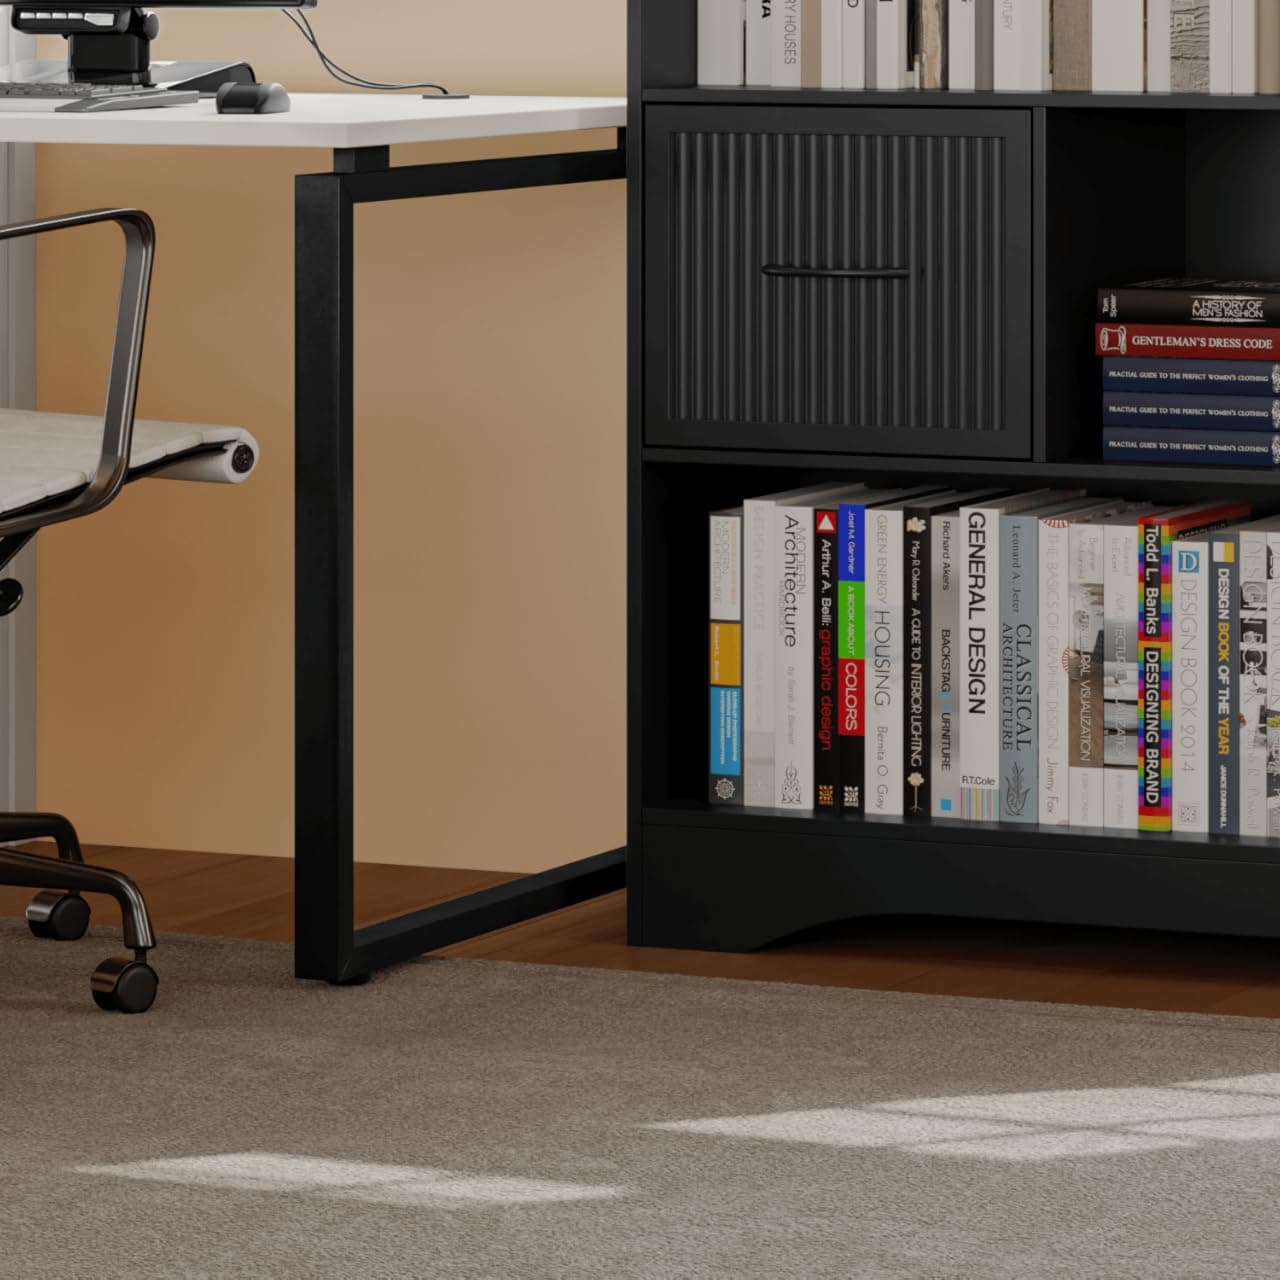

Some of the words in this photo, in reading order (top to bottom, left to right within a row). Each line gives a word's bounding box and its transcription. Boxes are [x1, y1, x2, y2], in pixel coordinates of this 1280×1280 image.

[784, 16, 797, 65] HOUSES
[1193, 301, 1200, 309] A
[1203, 300, 1243, 310] HISTORY
[1247, 301, 1262, 310] OF
[1226, 309, 1264, 318] FASHION
[1209, 336, 1241, 348] DRESS
[1244, 337, 1272, 349] CODE
[821, 539, 832, 578] Arthur
[942, 521, 951, 559] Richard
[1011, 525, 1021, 569] Leonard
[1145, 526, 1159, 562] Todd
[784, 514, 799, 648] Architecture
[821, 580, 832, 594] A.
[942, 561, 951, 591] Akers
[968, 512, 985, 620] GENERAL
[1011, 571, 1021, 584] A.
[1145, 568, 1159, 580] L.
[1011, 588, 1021, 613] Jeter
[1145, 588, 1159, 634] Banks
[1180, 579, 1197, 651] DESIGN
[1218, 568, 1229, 619] DESIGN
[817, 629, 833, 691] graphic
[874, 611, 891, 706] HOUSING
[1218, 622, 1229, 661] BOOK
[968, 627, 985, 714] DESIGN
[1002, 624, 1013, 751] ARCHITECTURE
[1016, 624, 1032, 752] CLASSICAL
[1180, 658, 1197, 718] BOOK
[1218, 666, 1229, 684] OF
[844, 662, 857, 730] COLORS
[1146, 651, 1159, 742] DESIGNING
[1218, 688, 1229, 714] THE
[818, 696, 833, 750] design
[1218, 718, 1229, 755] YEAR
[1180, 724, 1197, 773] 2014
[1146, 749, 1159, 804] BRAND
